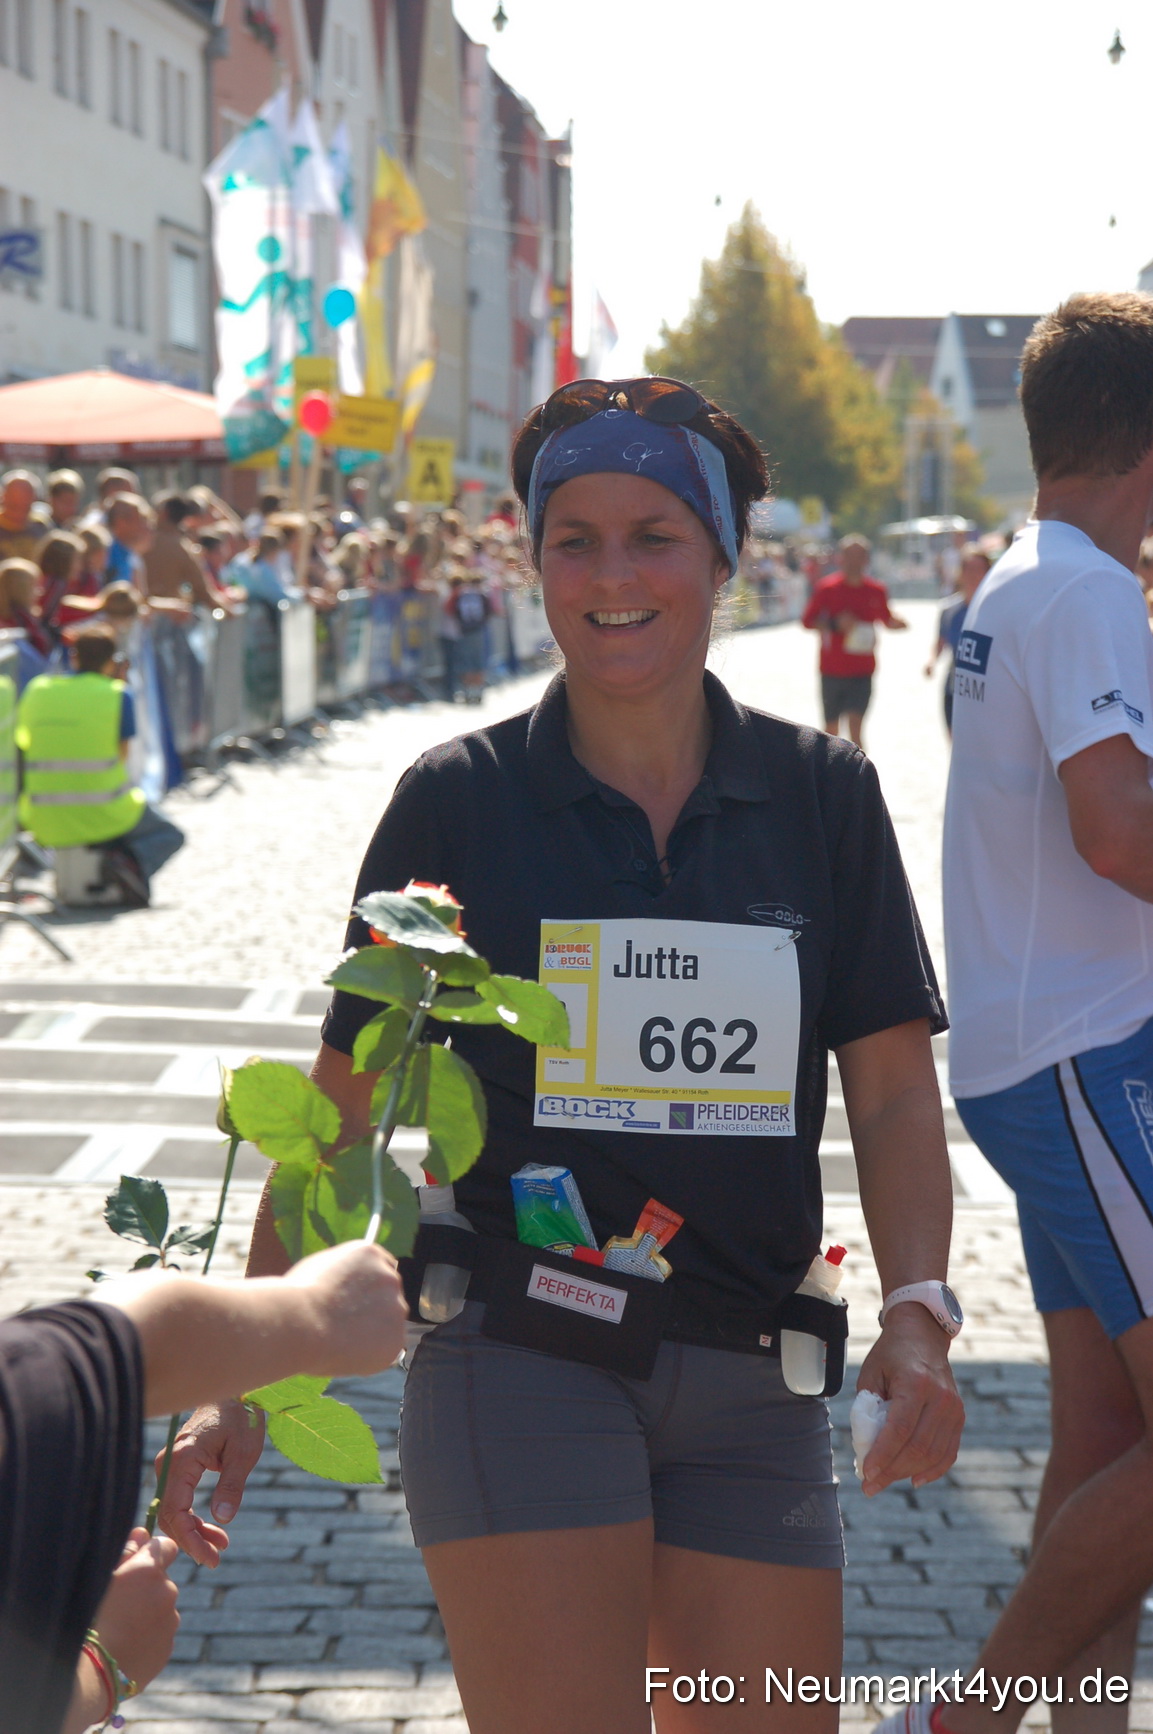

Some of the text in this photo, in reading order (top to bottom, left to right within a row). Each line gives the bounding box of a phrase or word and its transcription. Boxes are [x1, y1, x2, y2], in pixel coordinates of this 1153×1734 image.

[775, 910, 804, 925] ODLO
[613, 940, 699, 980] Jutta
[639, 1016, 758, 1075] 662
[539, 1096, 636, 1120] BOCK
[697, 1103, 790, 1122] PFLEIDERER
[697, 1123, 791, 1133] AKTIENGESELLSCHAFT
[536, 1275, 616, 1313] PERFEKTA
[782, 1514, 828, 1528] adida
